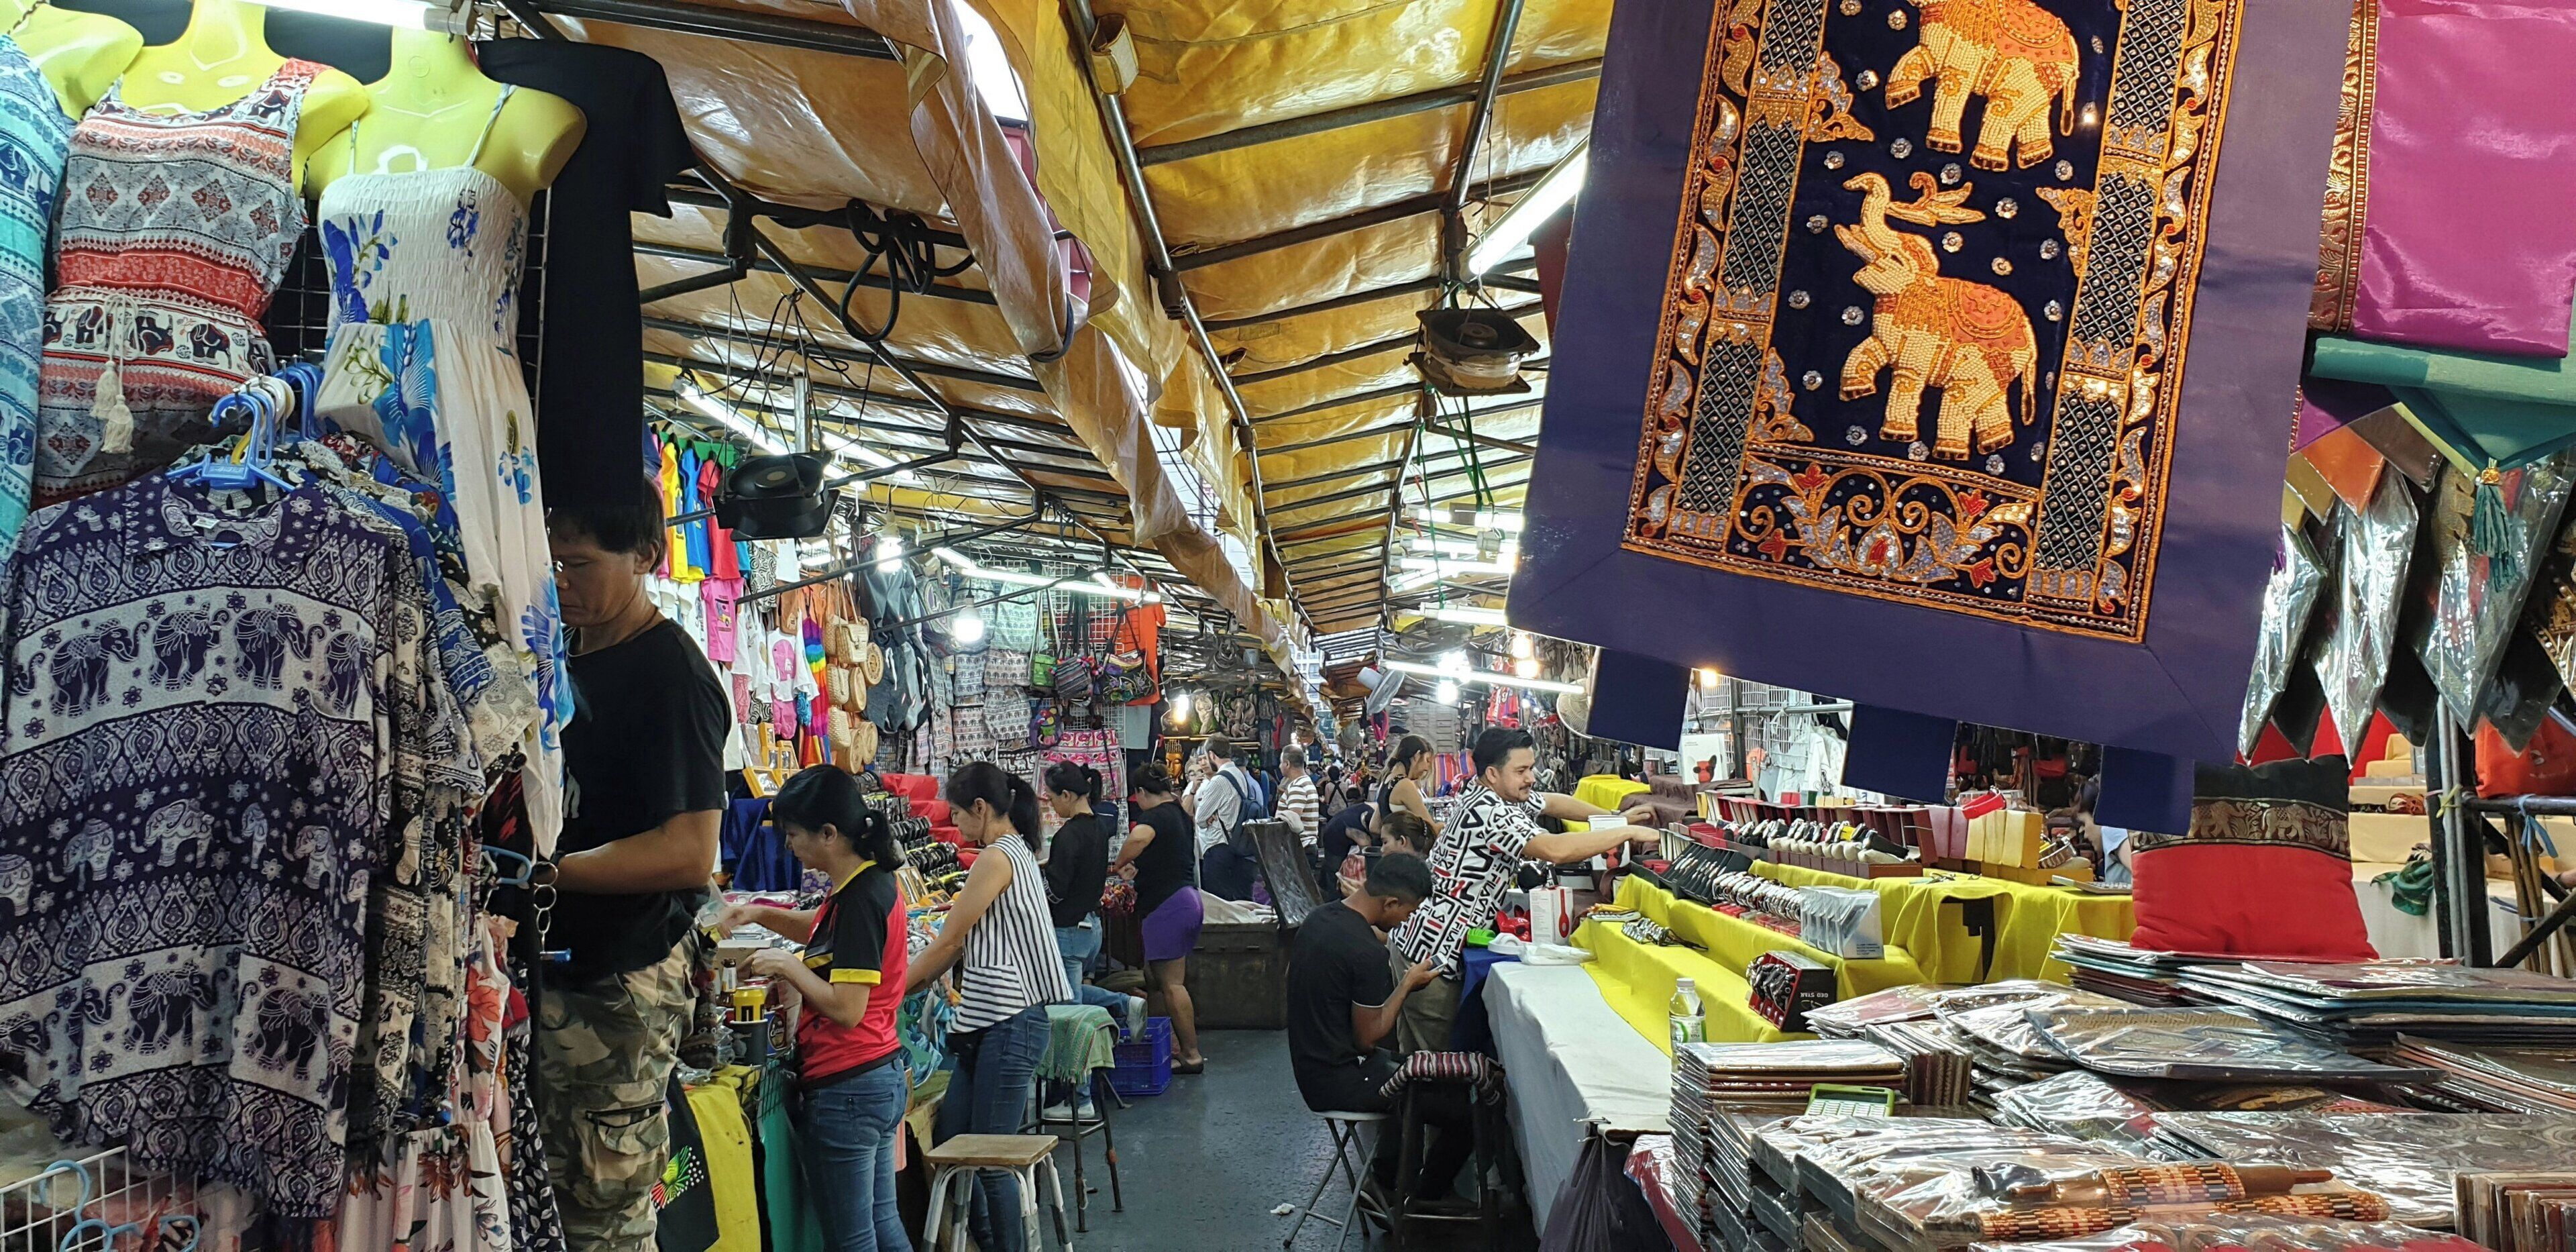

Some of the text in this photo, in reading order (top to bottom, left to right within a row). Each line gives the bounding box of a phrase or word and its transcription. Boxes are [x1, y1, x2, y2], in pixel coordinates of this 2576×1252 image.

[1480, 873, 1501, 896] FILA
[1421, 904, 1445, 923] FILA
[1470, 898, 1489, 925] FILA
[1446, 921, 1463, 941] FILA
